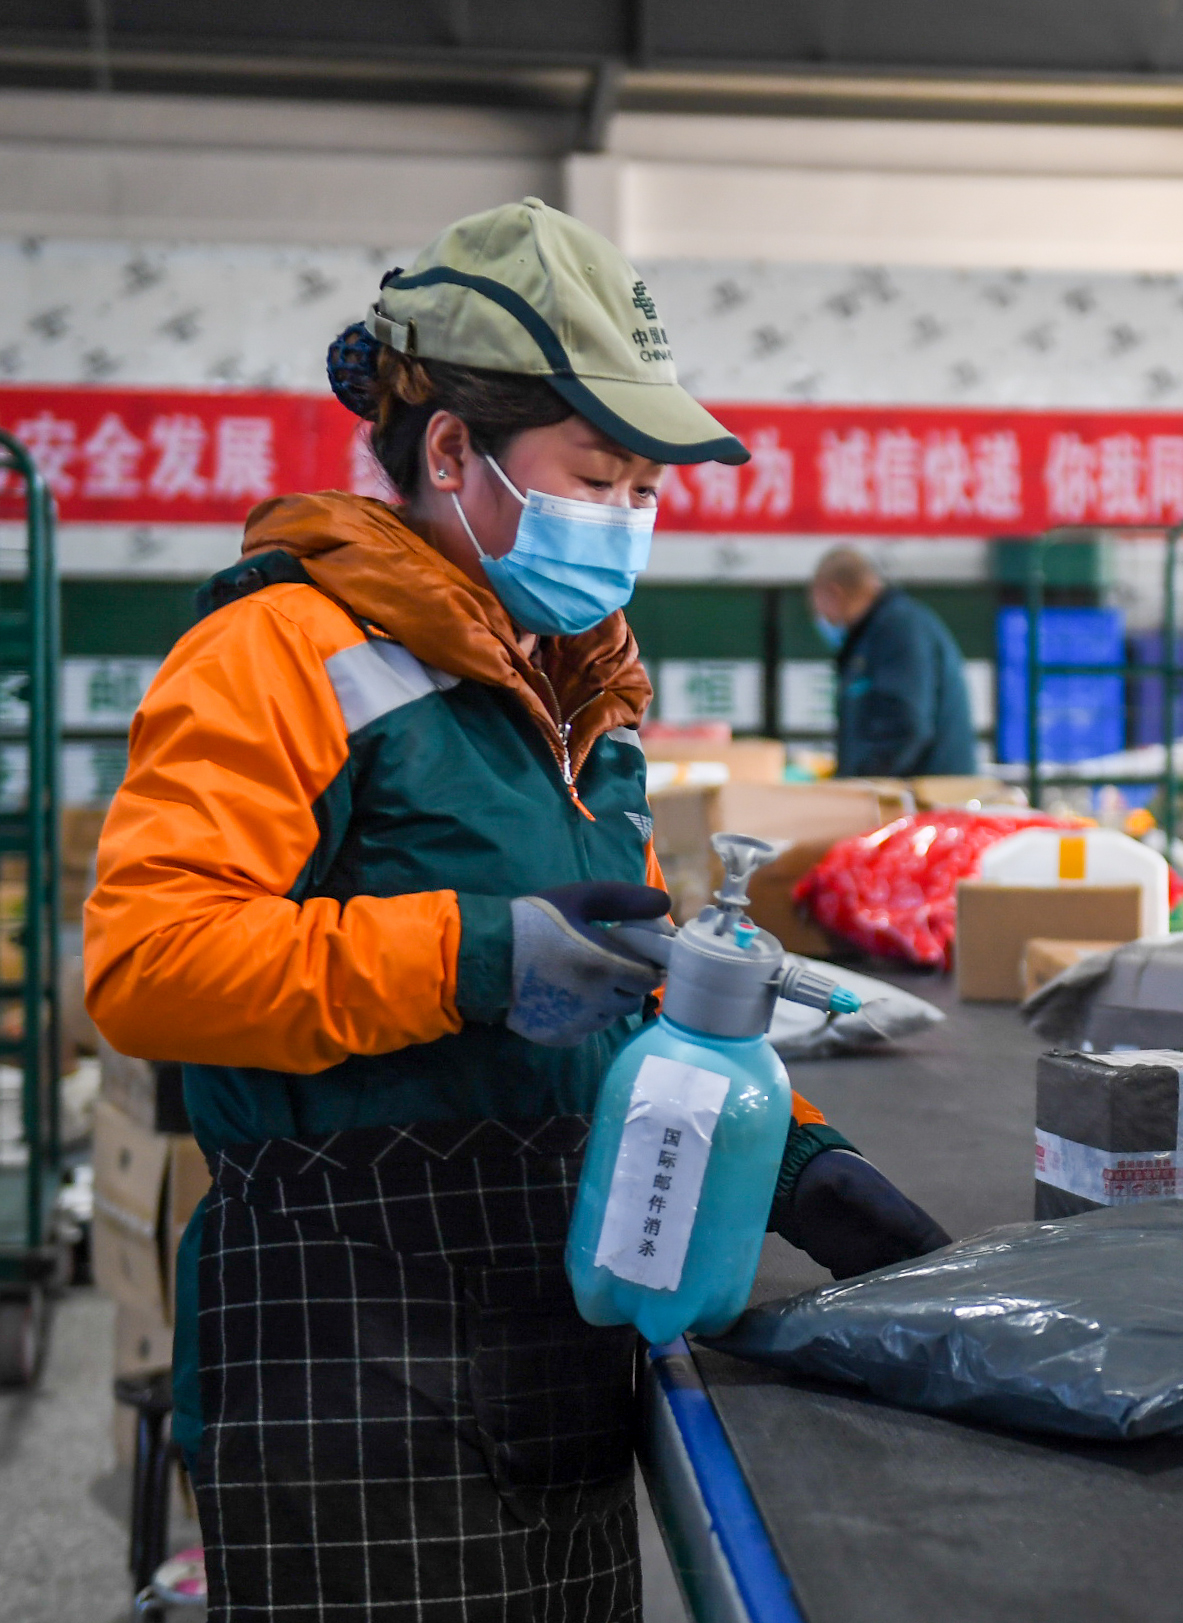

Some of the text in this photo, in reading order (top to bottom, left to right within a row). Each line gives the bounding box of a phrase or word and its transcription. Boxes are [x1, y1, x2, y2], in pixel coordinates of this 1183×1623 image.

[0, 411, 274, 500] 安全发展
[637, 1126, 682, 1258] 国际邮件消杀
